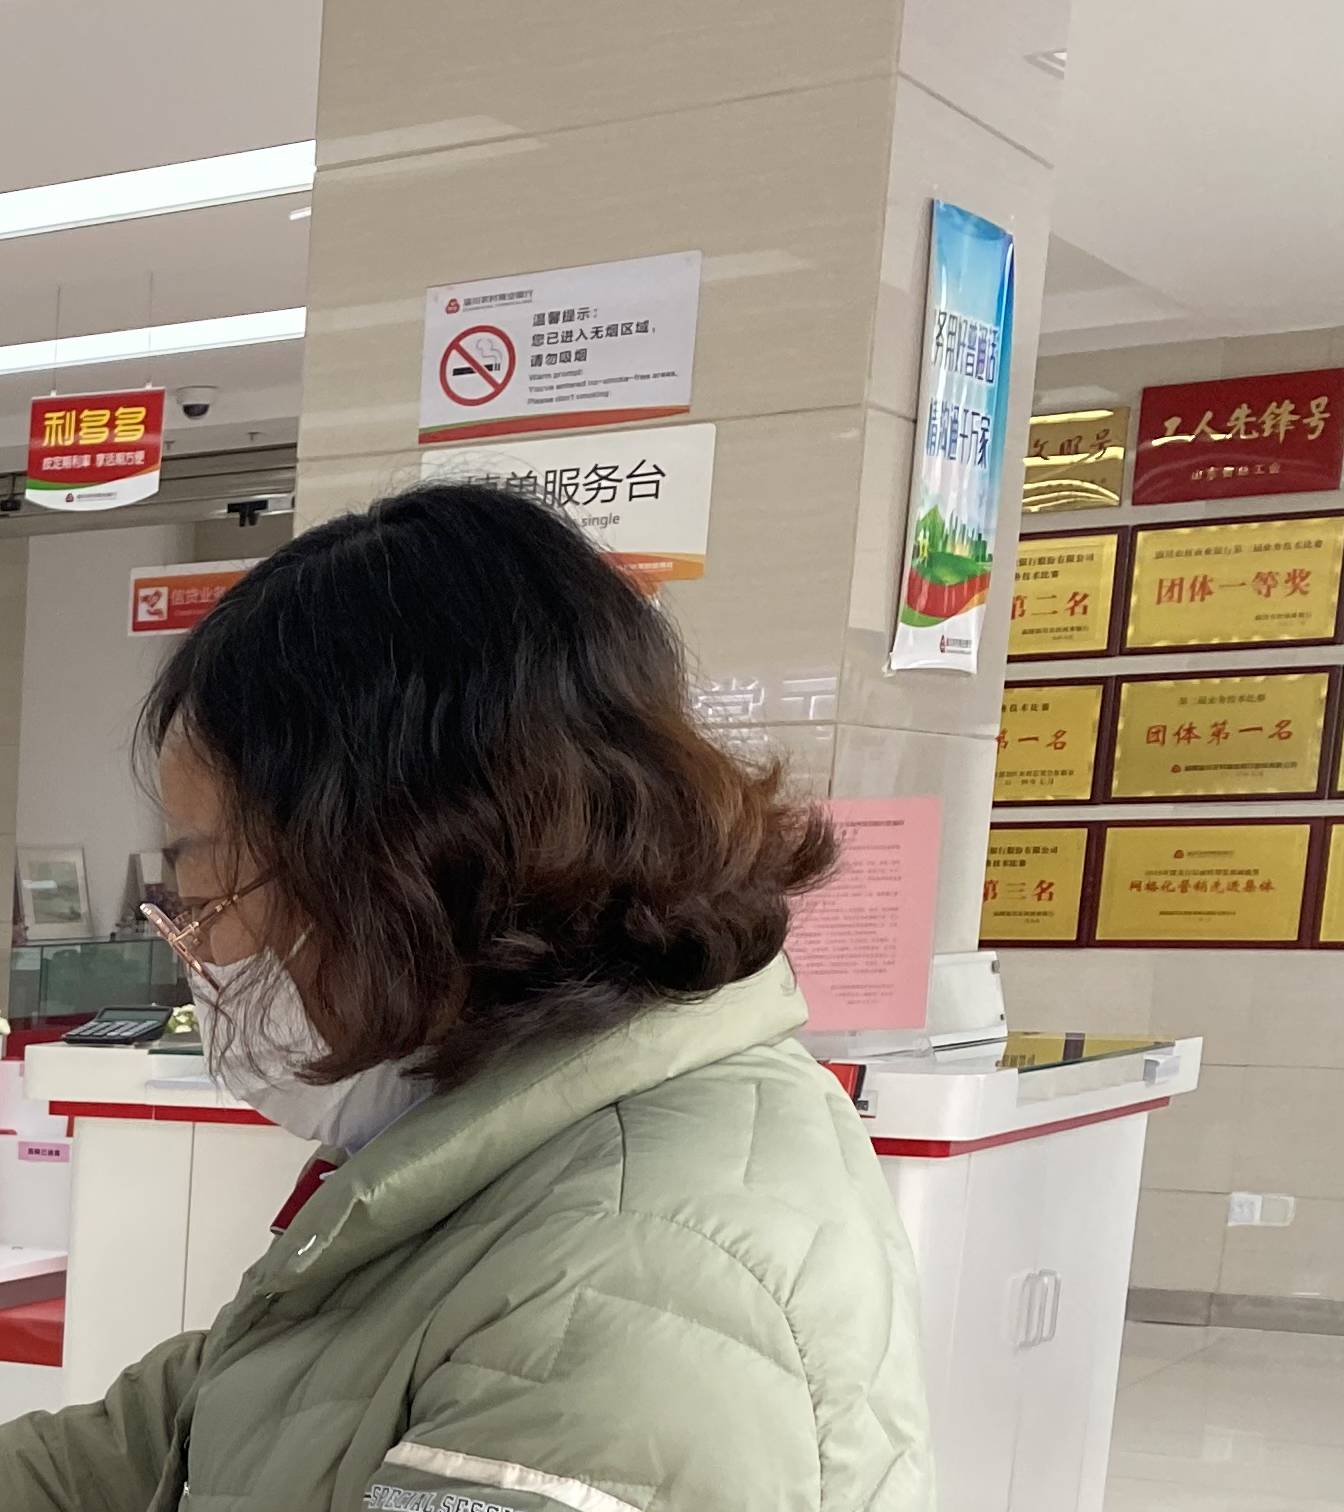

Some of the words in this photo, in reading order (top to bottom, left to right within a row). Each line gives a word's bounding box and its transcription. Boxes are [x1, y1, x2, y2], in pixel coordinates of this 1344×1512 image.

[529, 348, 588, 368] 请勿吸烟
[42, 407, 146, 447] 利多多
[1163, 396, 1330, 444] 工人先锋号
[580, 513, 621, 529] single
[1155, 568, 1311, 605] 团体一等奖
[1145, 720, 1293, 746] 团体第一名
